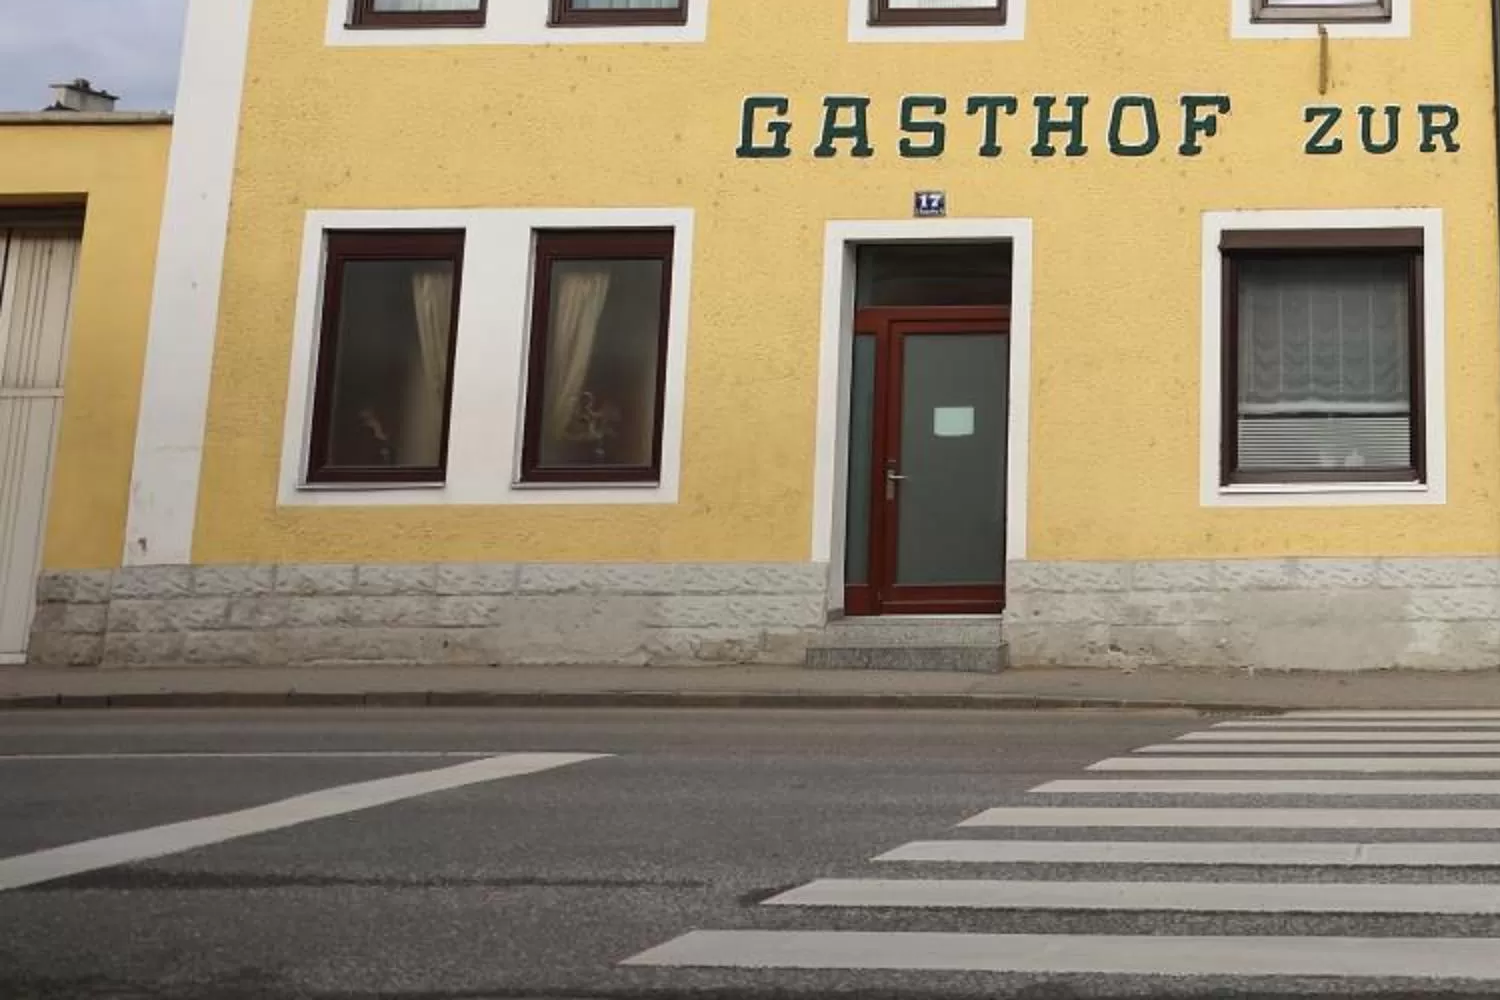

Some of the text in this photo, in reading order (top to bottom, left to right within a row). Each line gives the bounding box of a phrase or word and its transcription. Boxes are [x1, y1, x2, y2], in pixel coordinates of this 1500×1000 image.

[736, 96, 1230, 158] GASTHOF
[1305, 105, 1460, 154] ZUR
[919, 193, 943, 208] 17
